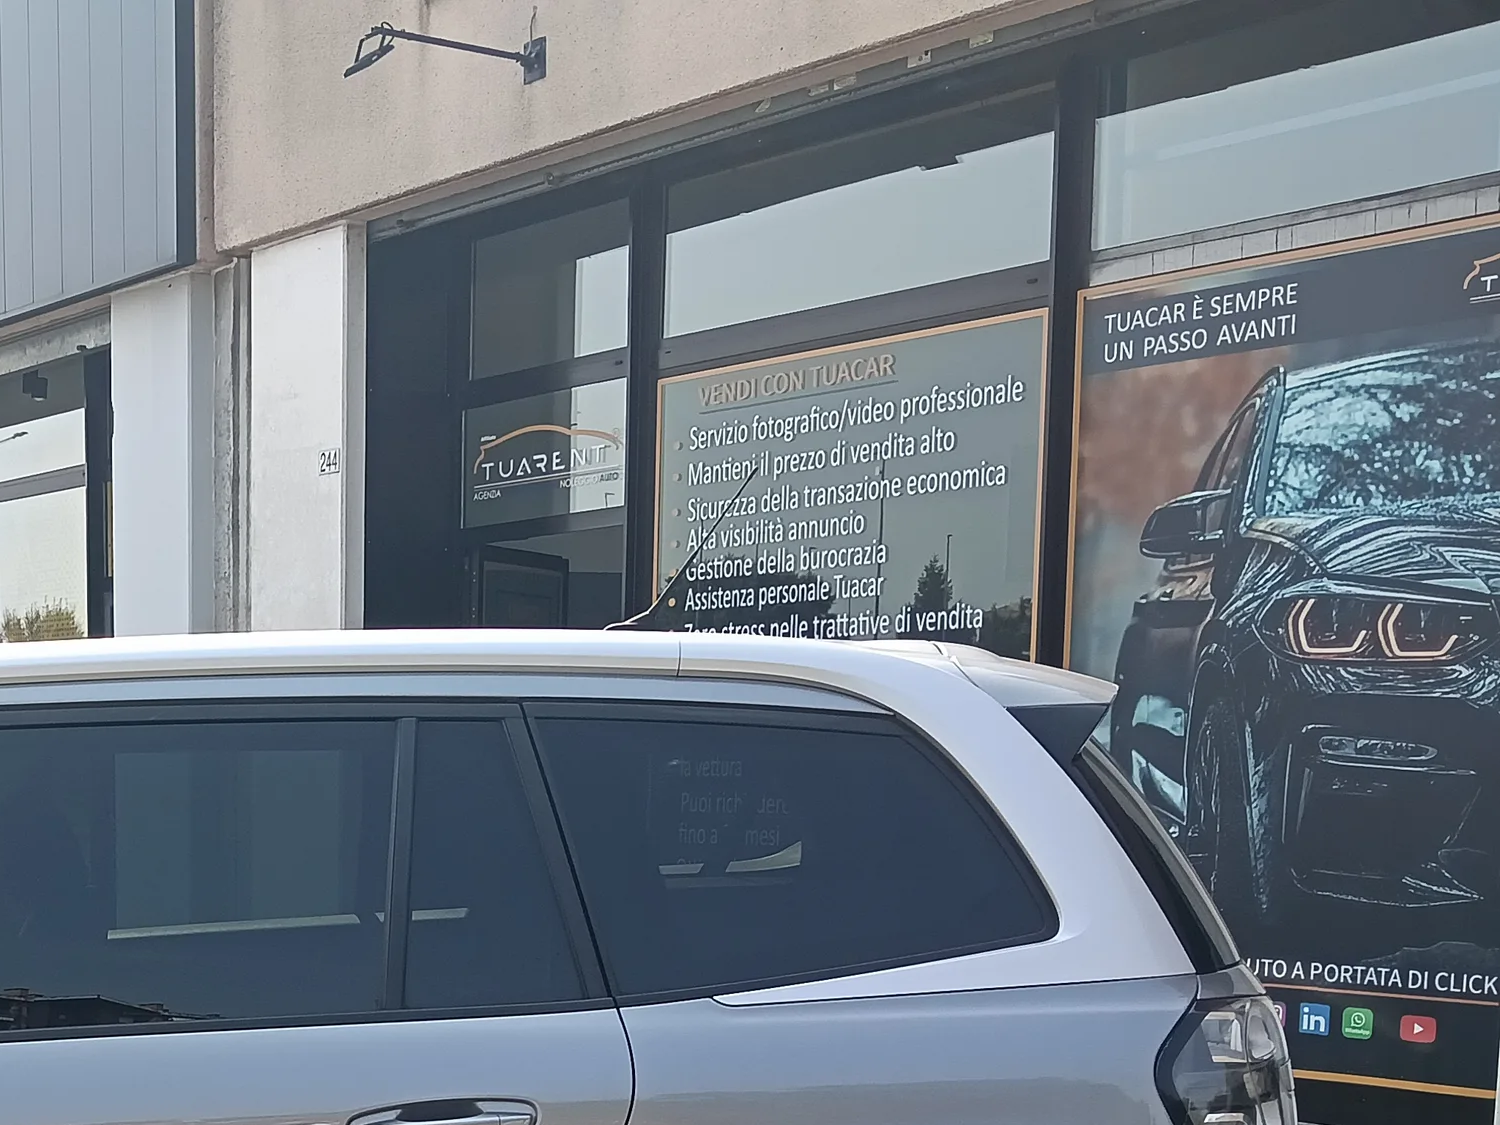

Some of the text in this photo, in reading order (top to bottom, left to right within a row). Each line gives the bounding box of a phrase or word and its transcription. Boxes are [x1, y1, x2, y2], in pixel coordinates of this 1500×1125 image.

[1104, 283, 1298, 334] TUACAR È SEMPRE
[1103, 314, 1297, 363] UN PASSO AVANTI
[699, 353, 896, 406] VENDI CON TUACAR
[689, 374, 1024, 451] Servizio fotografico/video professionale
[319, 452, 338, 473] 244
[688, 426, 955, 486] Mantieni il prezzo di vendita alto
[473, 490, 501, 501] AGENZIA
[687, 460, 1007, 522] Sicurezza della transazione economica
[686, 509, 865, 552] Alta visibilità annuncio
[685, 539, 887, 582] Gestione della burocrazia
[685, 574, 885, 611] Assistenza personale Tuacar
[770, 614, 808, 639] nelle
[813, 609, 890, 640] trattative
[895, 606, 911, 633] di
[916, 602, 983, 631] vendita
[1291, 961, 1305, 979] A
[1310, 962, 1402, 988] PORTATA
[1408, 970, 1429, 991] DI
[1434, 972, 1498, 996] CLICK
[1302, 1006, 1327, 1032] in
